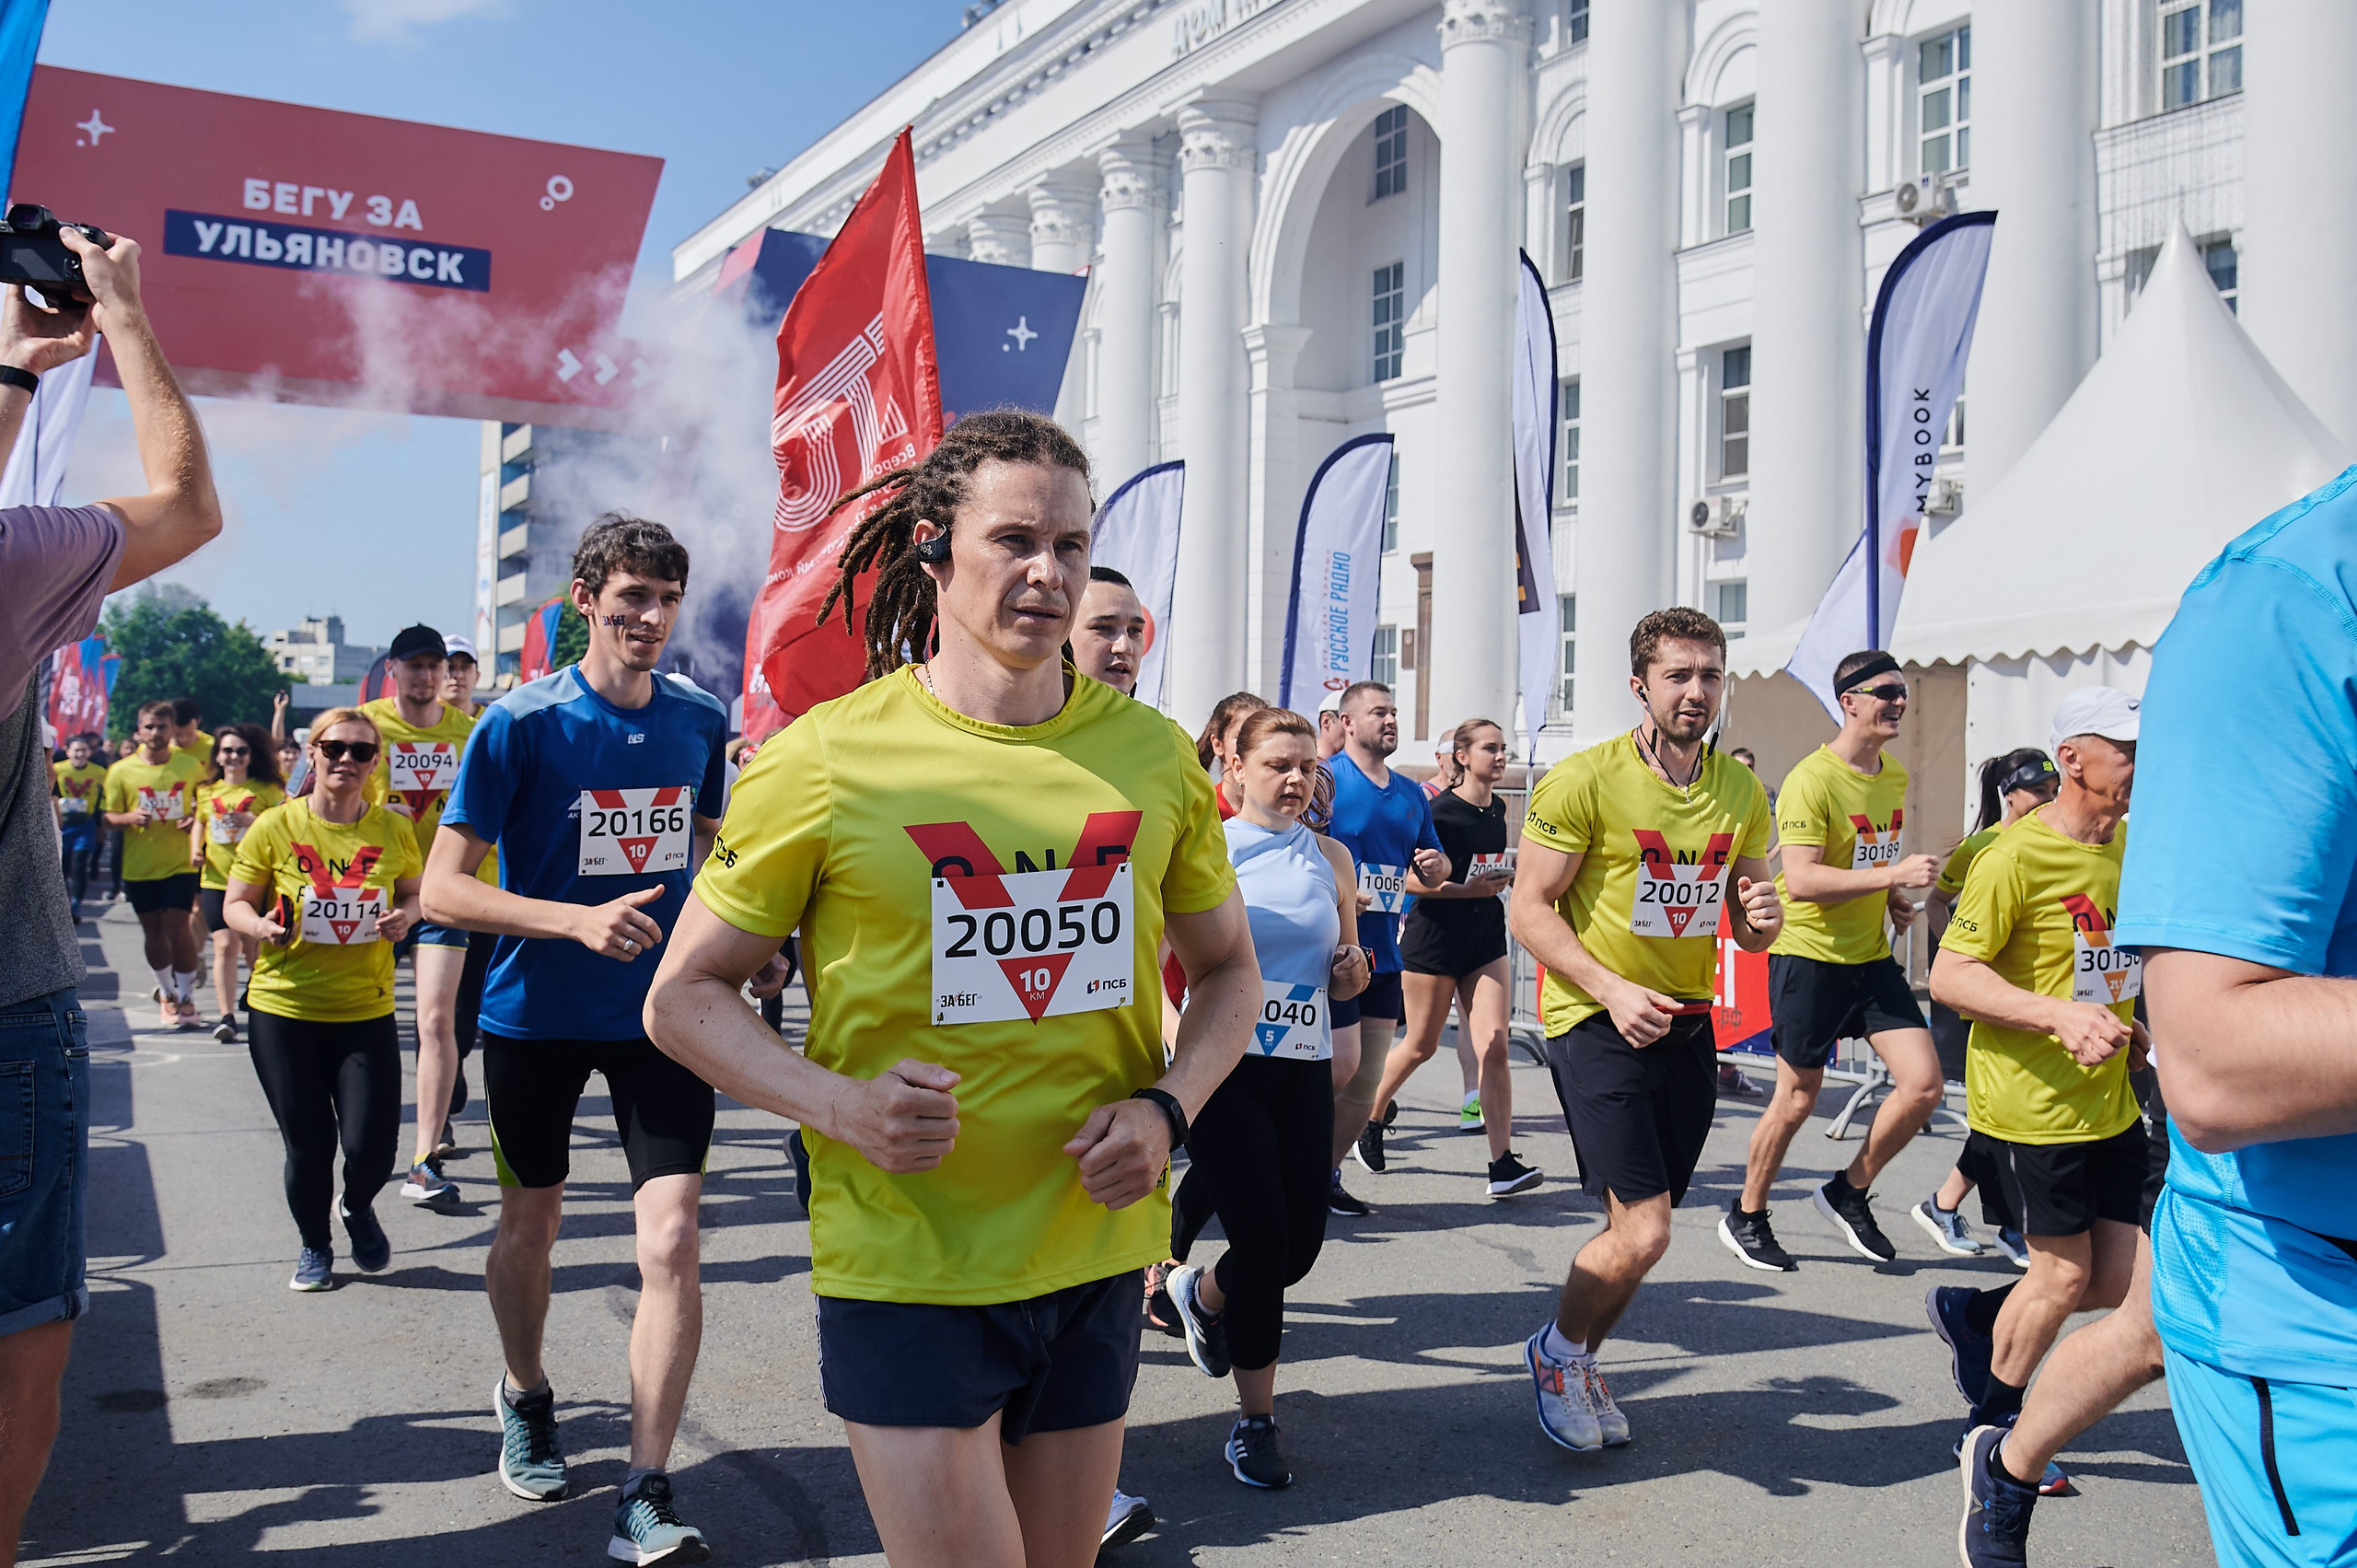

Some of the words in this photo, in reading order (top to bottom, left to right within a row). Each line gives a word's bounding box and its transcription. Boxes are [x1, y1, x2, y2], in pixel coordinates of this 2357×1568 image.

[243, 178, 354, 220] БЕГУ
[366, 195, 424, 231] ЗА
[193, 220, 465, 284] УЛЬЯНОВСК
[1914, 389, 1933, 512] MYBOOK
[1329, 605, 1350, 672] РУССКОЕ
[628, 734, 644, 744] NS
[396, 754, 452, 769] 20094
[588, 807, 684, 837] 20166
[1535, 818, 1558, 835] ПСБ
[1789, 820, 1806, 829] ПСБ
[629, 844, 646, 857] 10
[715, 835, 738, 868] ПСБ
[1858, 842, 1899, 861] 30189
[297, 855, 377, 877] ONE
[1364, 876, 1404, 893] 10061
[1640, 881, 1720, 904] 20012
[308, 900, 380, 919] 20114
[1385, 896, 1391, 906] 5
[1672, 912, 1687, 923] 10
[1956, 917, 1978, 932] ПСБ
[337, 925, 351, 935] 10
[945, 900, 1120, 958] 20050
[1019, 968, 1051, 993] 10
[1102, 979, 1127, 991] ПСБ
[1029, 991, 1045, 1001] КМ
[1260, 1000, 1316, 1027] 040
[1265, 1030, 1274, 1042] 5
